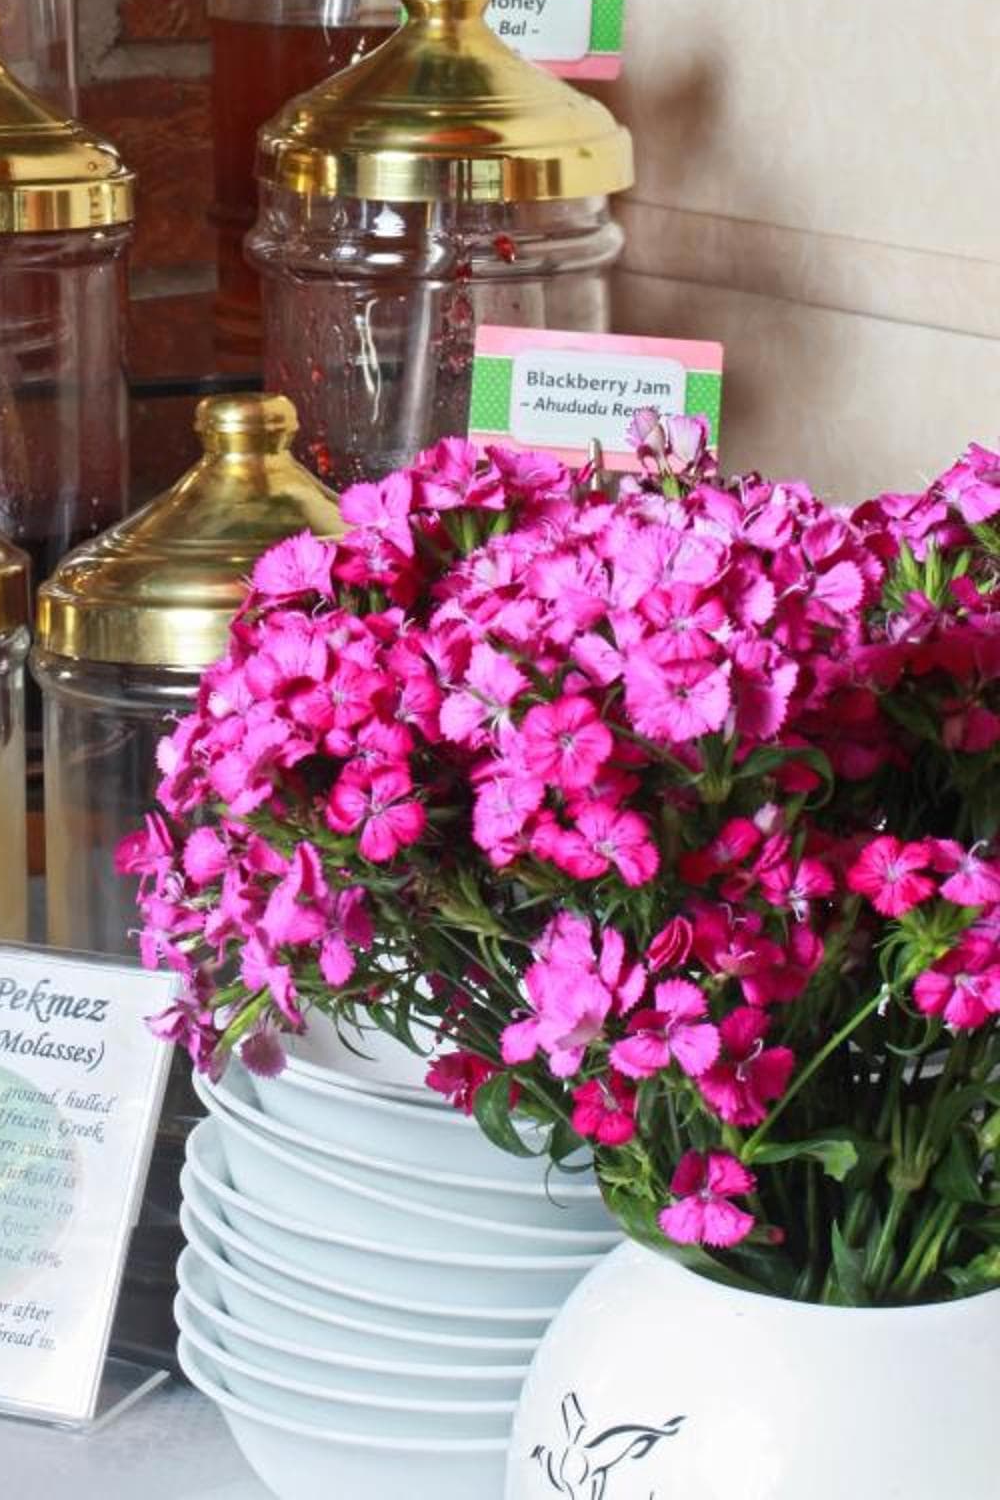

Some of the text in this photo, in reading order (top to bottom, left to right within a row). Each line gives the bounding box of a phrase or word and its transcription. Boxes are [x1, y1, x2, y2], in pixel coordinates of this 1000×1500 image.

[499, 20, 527, 36] Bal
[527, 371, 671, 396] Blackberry Jam
[533, 397, 607, 416] Ahududu
[65, 1090, 118, 1114] hulled
[12, 1301, 52, 1322] after
